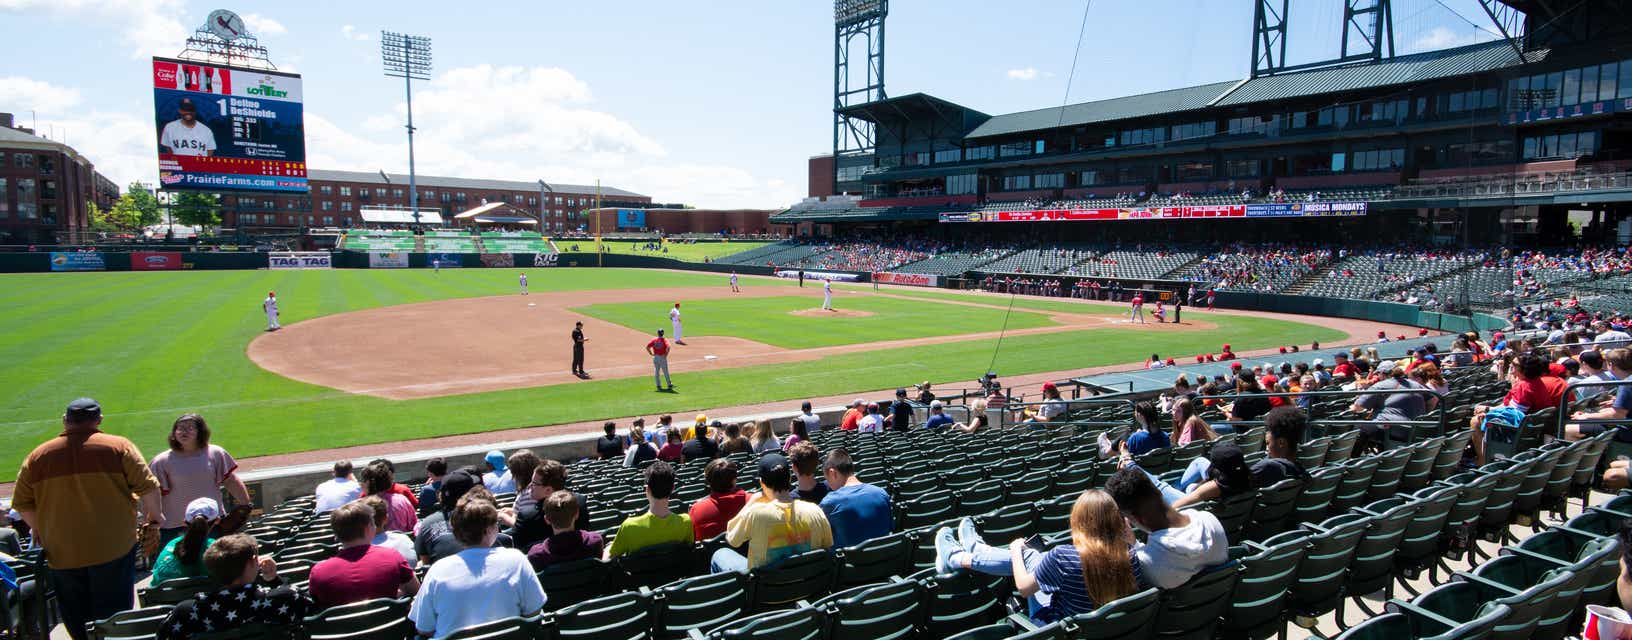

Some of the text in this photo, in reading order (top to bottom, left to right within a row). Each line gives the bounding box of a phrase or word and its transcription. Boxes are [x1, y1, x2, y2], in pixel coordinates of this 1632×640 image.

[186, 36, 267, 55] AUTOZONE
[209, 48, 247, 60] PARK
[247, 84, 288, 97] LOTTERY
[216, 99, 227, 116] 1
[230, 98, 260, 109] Delino
[230, 106, 277, 119] DeShields
[172, 138, 207, 152] NASH
[187, 175, 275, 187] PrairieFarms.com
[1331, 202, 1365, 211] MONDAYS
[271, 257, 329, 266] TAG TAG
[893, 274, 929, 285] AutoZone
